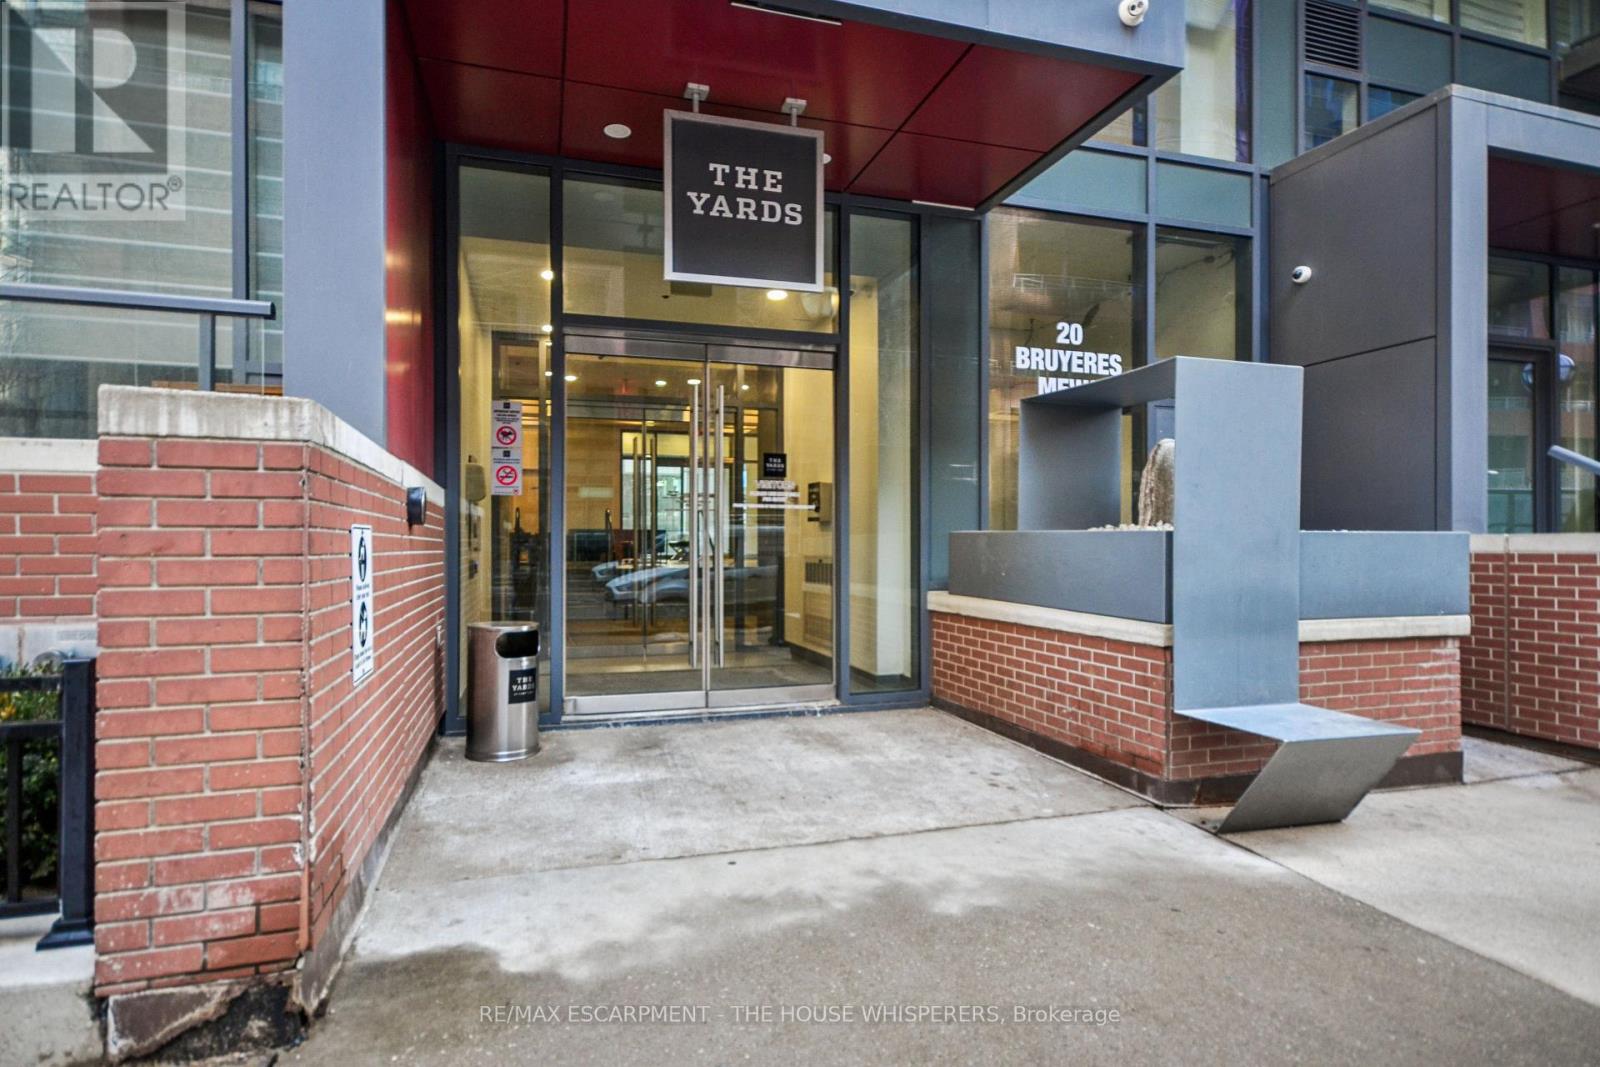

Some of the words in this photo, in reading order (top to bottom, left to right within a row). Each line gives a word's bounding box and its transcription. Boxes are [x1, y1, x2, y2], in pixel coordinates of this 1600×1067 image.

[708, 162, 783, 193] THE
[686, 191, 803, 225] YARDS
[1056, 321, 1083, 345] 20
[1015, 346, 1123, 376] BRUYERES
